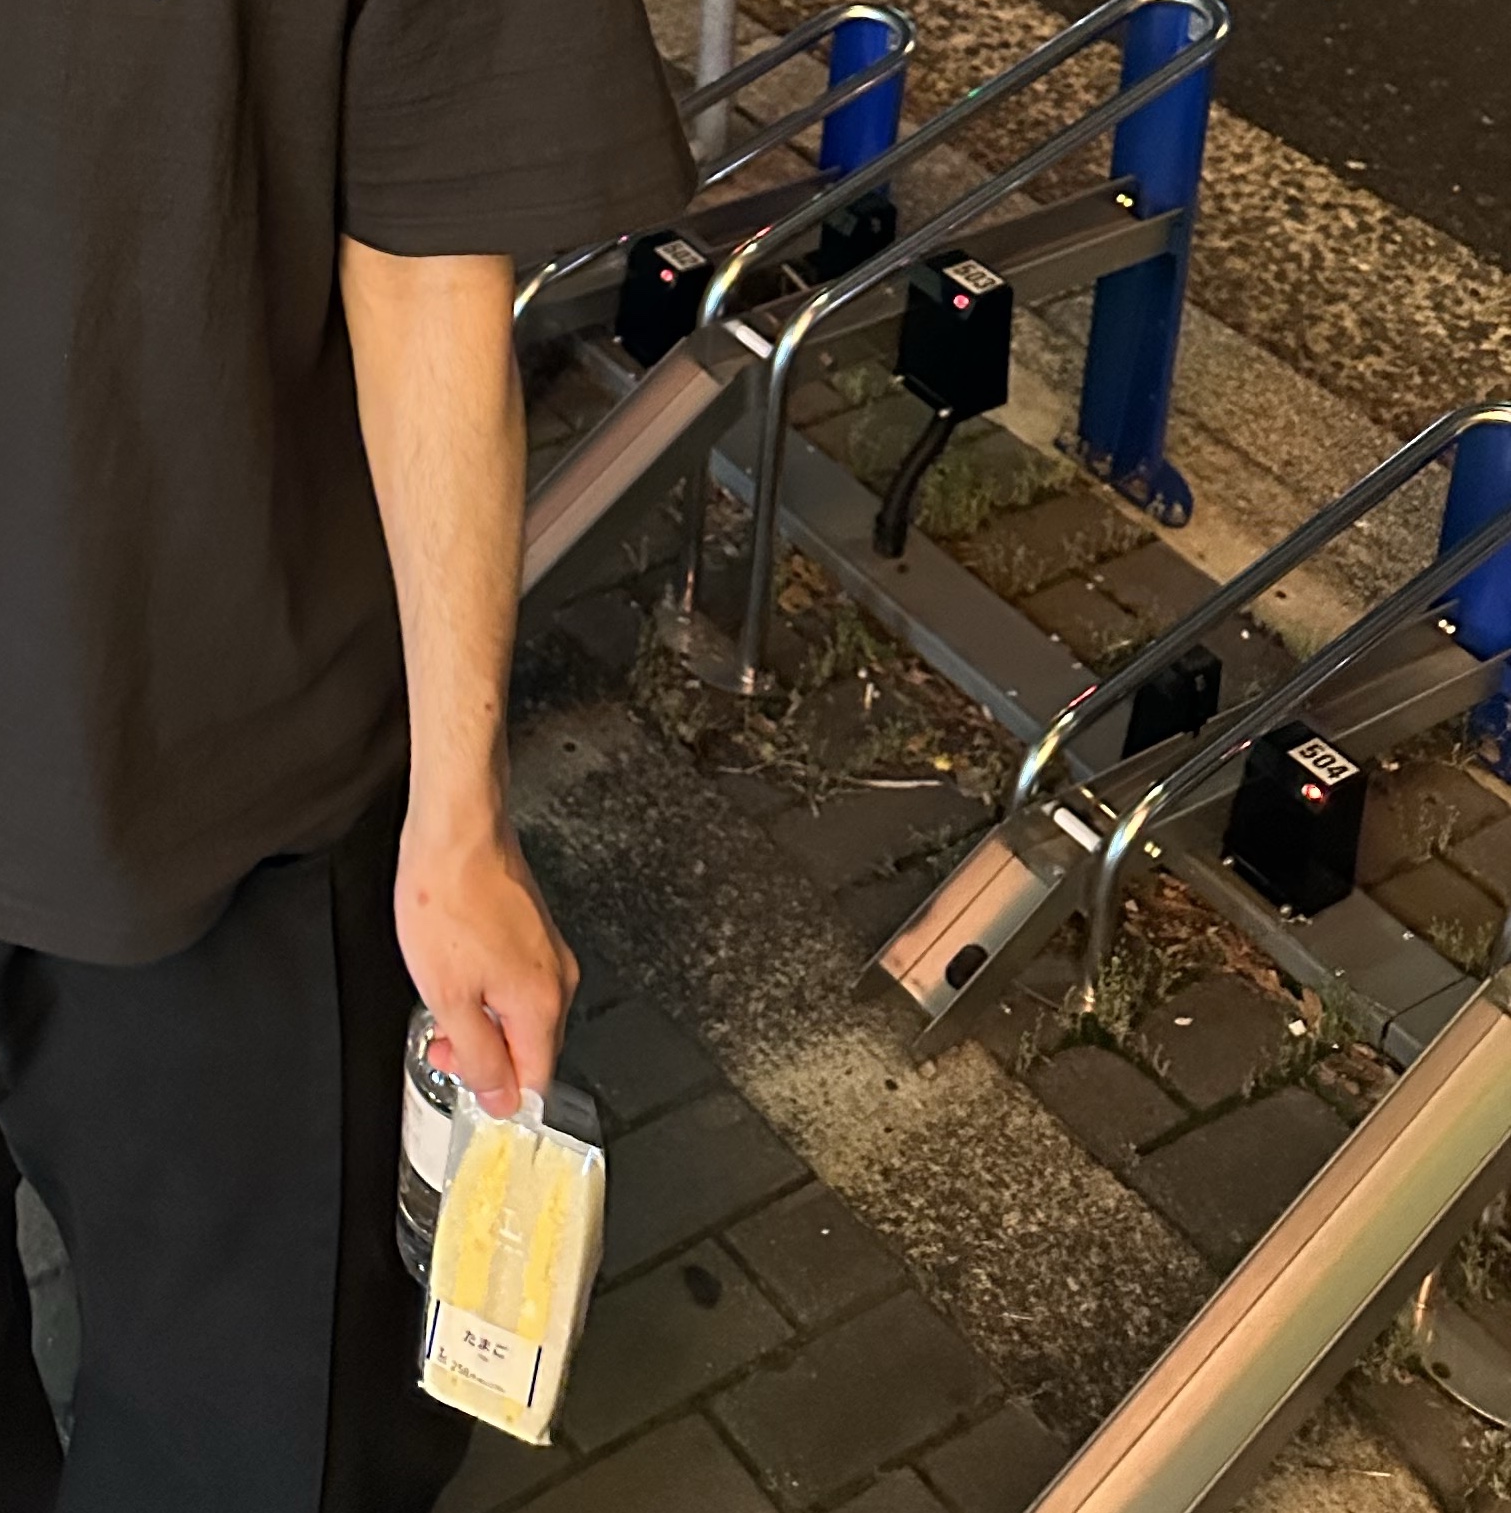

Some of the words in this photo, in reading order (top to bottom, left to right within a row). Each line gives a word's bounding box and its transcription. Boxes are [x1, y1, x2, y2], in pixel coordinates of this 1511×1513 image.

[953, 264, 996, 289] 503
[1299, 744, 1349, 779] 504
[463, 1329, 510, 1360] たまご
